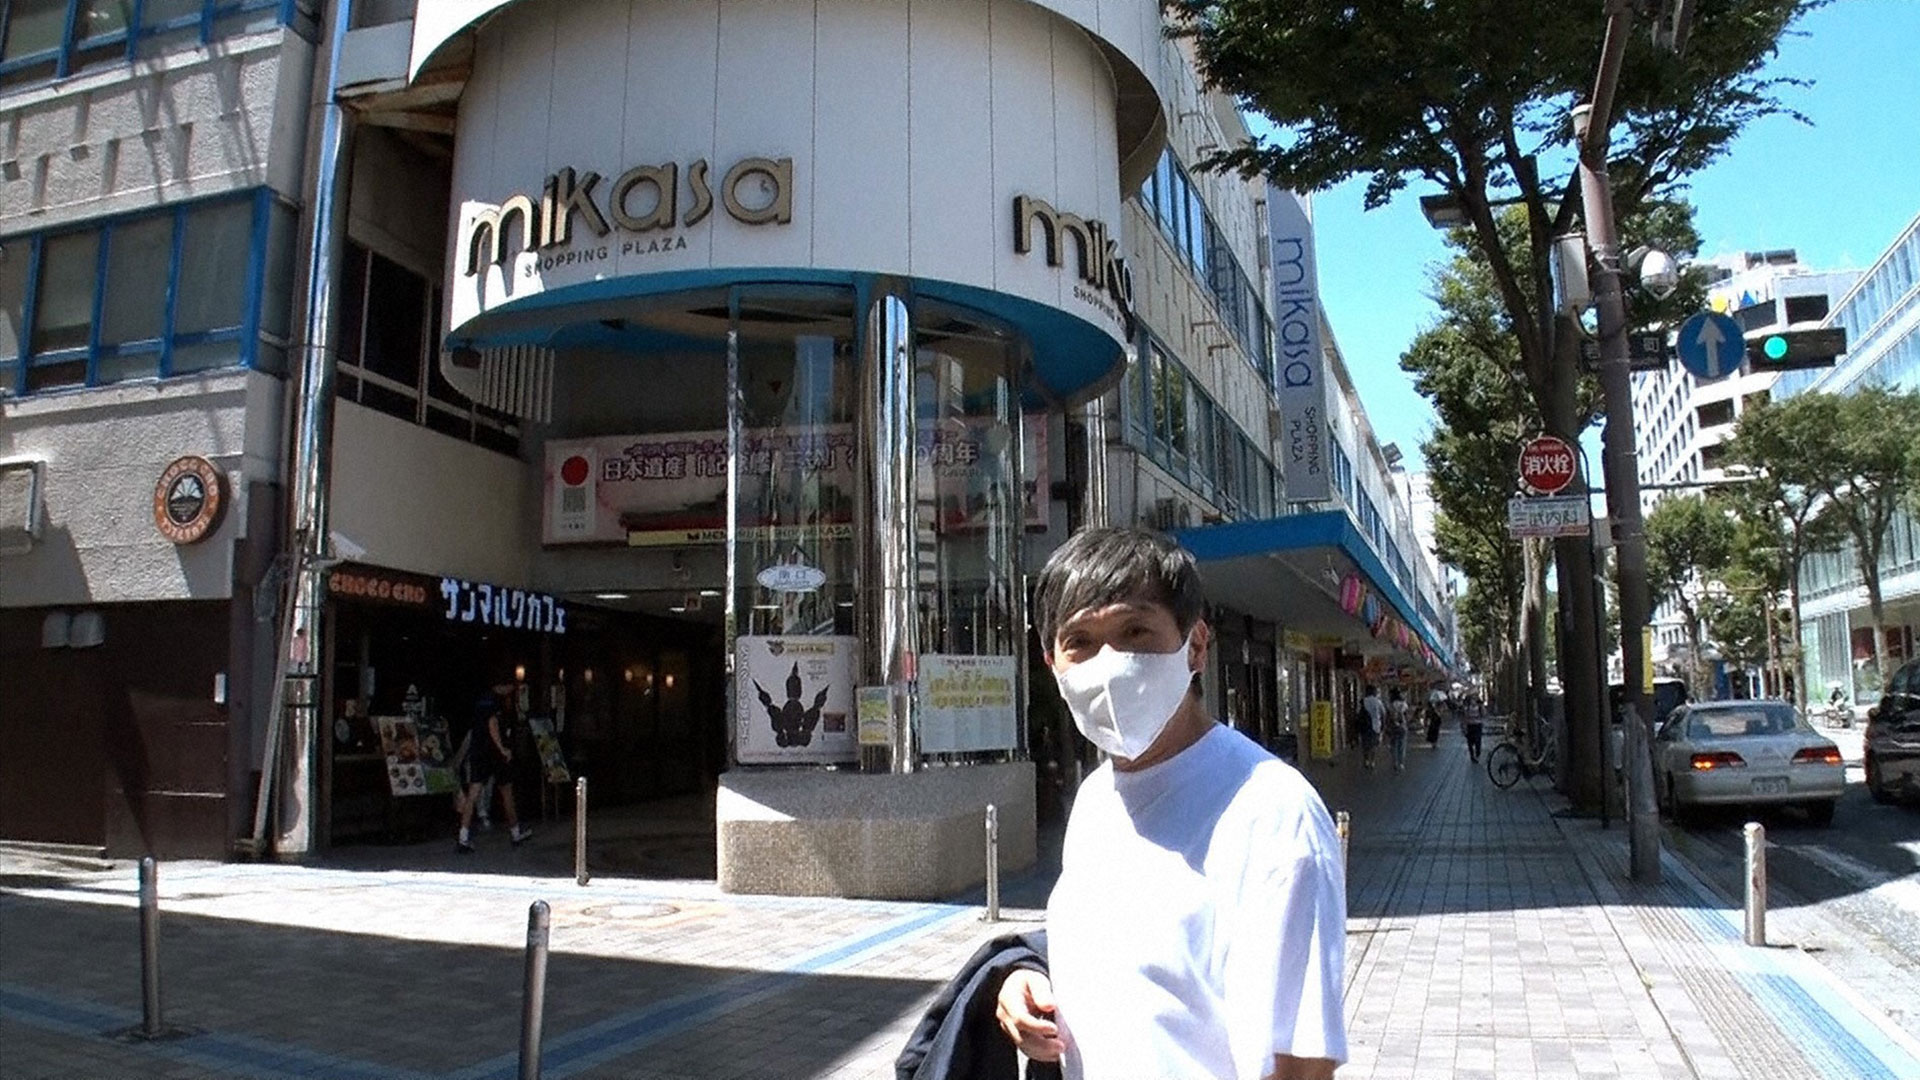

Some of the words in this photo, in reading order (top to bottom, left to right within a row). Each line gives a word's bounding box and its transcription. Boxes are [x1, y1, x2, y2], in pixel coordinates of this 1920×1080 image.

[464, 157, 792, 277] mikasa
[524, 246, 608, 278] SHOPPING
[622, 235, 687, 257] PLAZA
[1277, 237, 1313, 389] mikasa
[1291, 420, 1304, 463] PLAZA
[1304, 406, 1320, 476] SHOPPING
[1525, 454, 1571, 476] 消火栓
[440, 578, 566, 634] サンマルクカフェ
